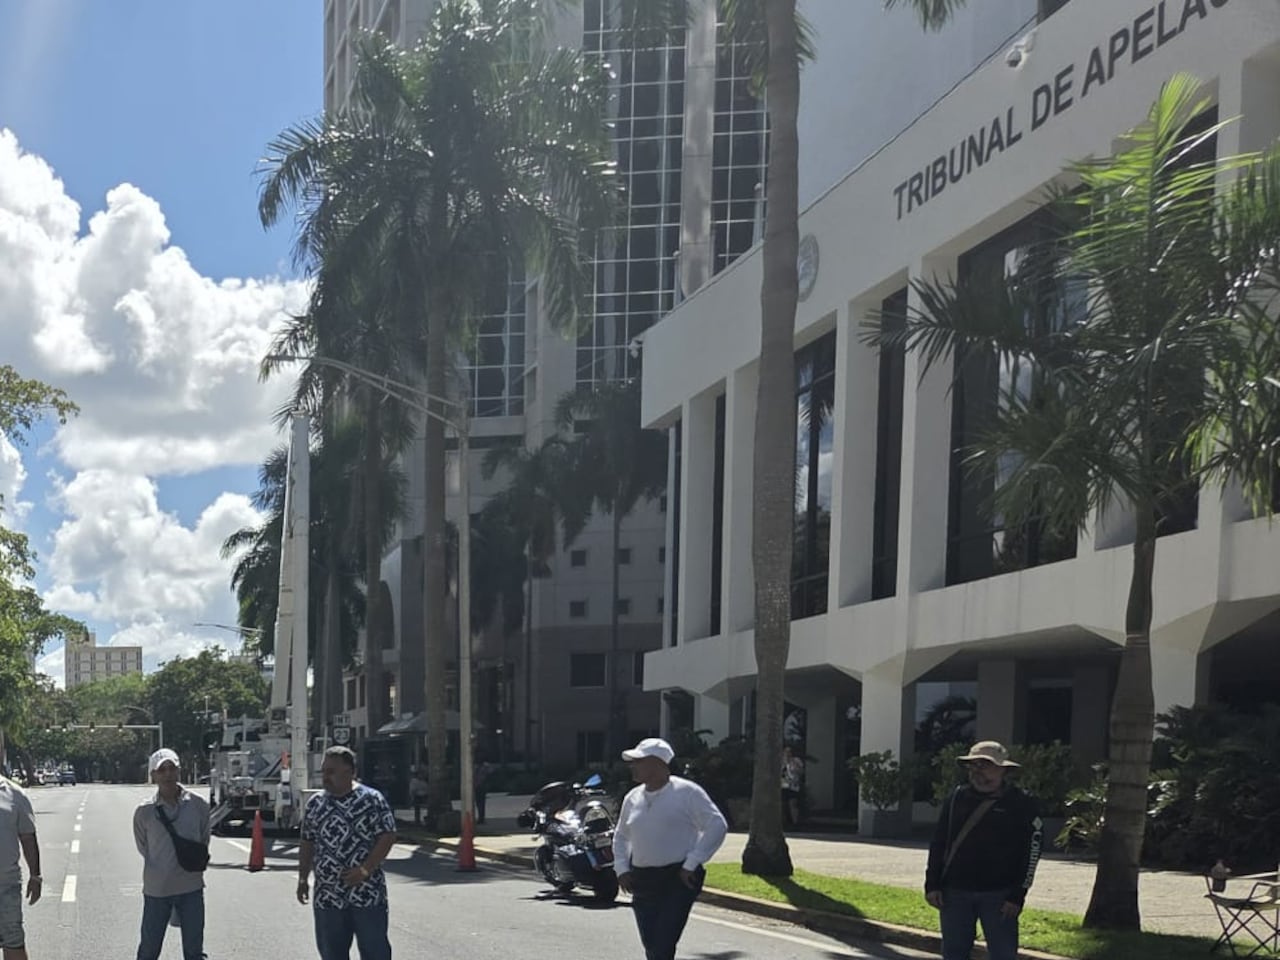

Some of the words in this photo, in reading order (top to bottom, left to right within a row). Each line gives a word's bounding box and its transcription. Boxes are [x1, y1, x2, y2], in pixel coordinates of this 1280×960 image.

[893, 106, 1023, 221] TRIBUNAL
[1031, 64, 1074, 131] DE
[1081, 0, 1229, 98] APELA
